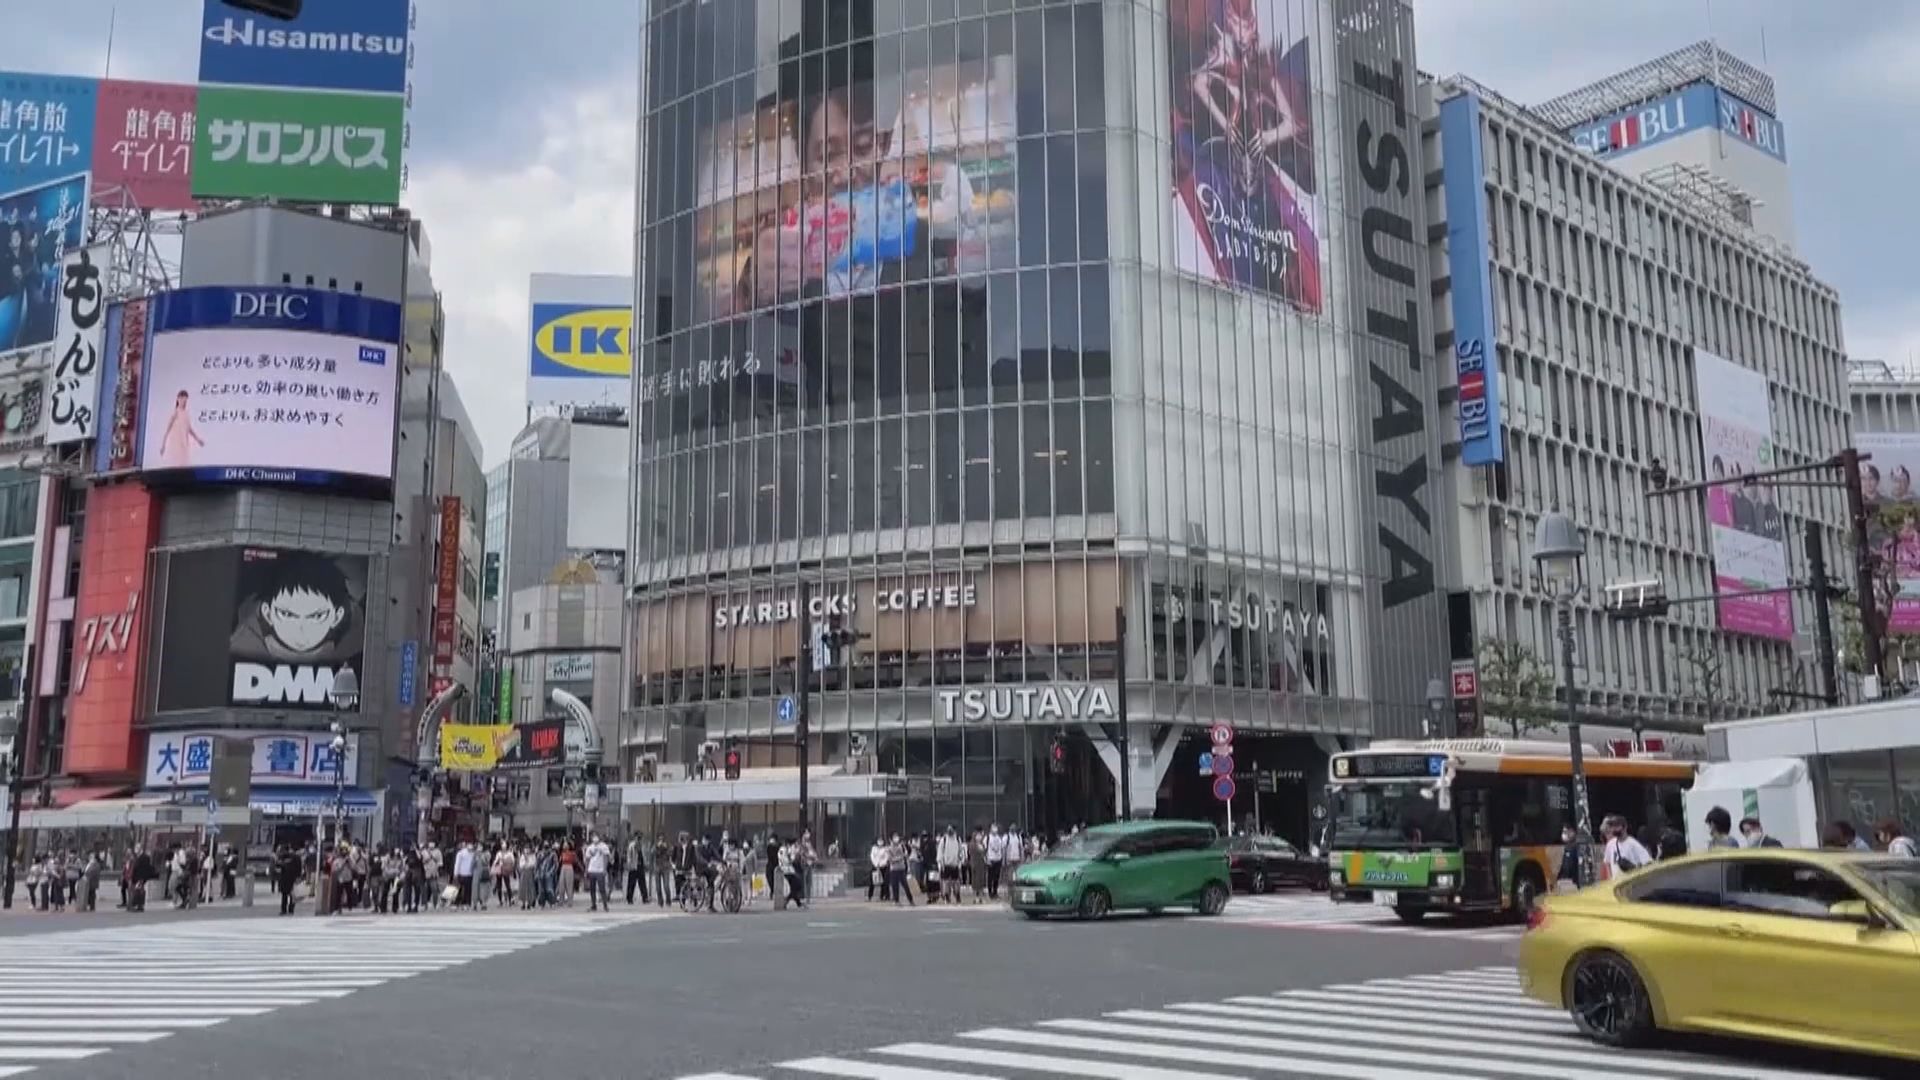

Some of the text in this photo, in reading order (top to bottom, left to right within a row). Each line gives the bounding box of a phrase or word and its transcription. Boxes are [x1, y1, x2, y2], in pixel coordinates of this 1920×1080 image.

[205, 18, 403, 56] Hisamitsu
[125, 107, 196, 143] 龍角散
[208, 118, 389, 169] サロンパス
[1574, 97, 1686, 155] SEIBU
[1721, 98, 1779, 155] SEIBU
[234, 291, 308, 319] DHC
[51, 250, 102, 434] もんじゃ
[553, 326, 632, 354] IK
[1353, 58, 1435, 611] TSUTAYA
[1458, 338, 1490, 441] SEIBU
[225, 468, 296, 482] DHC Channel
[715, 583, 977, 628] STARBUCKS COFFEE
[1210, 598, 1329, 640] TSUTAYA
[939, 686, 1114, 721] TSUTAYA
[156, 738, 343, 776] 大盛書店
